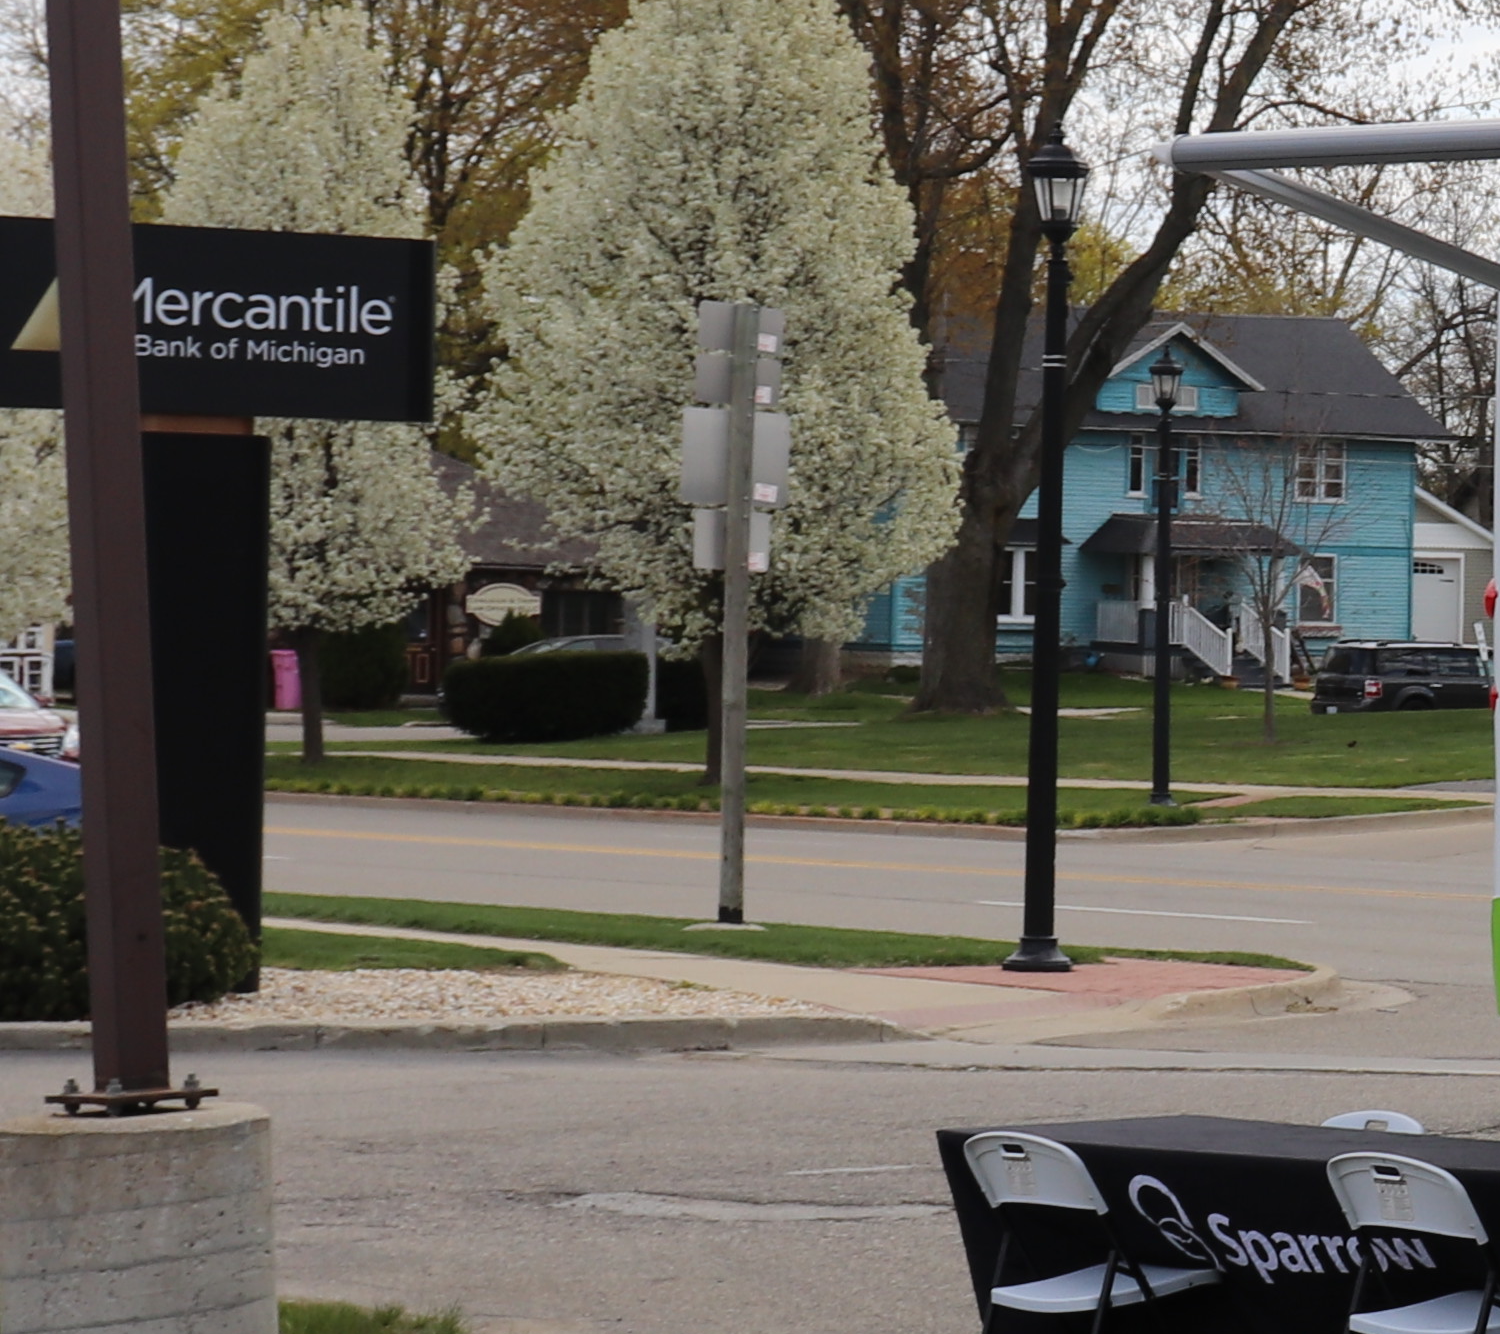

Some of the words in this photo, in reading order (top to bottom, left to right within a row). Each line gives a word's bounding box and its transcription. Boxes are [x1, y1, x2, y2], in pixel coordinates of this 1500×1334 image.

[134, 334, 202, 359] Bank
[210, 337, 239, 360] of
[246, 339, 365, 368] Michigan
[1207, 1213, 1437, 1284] Sparrow
